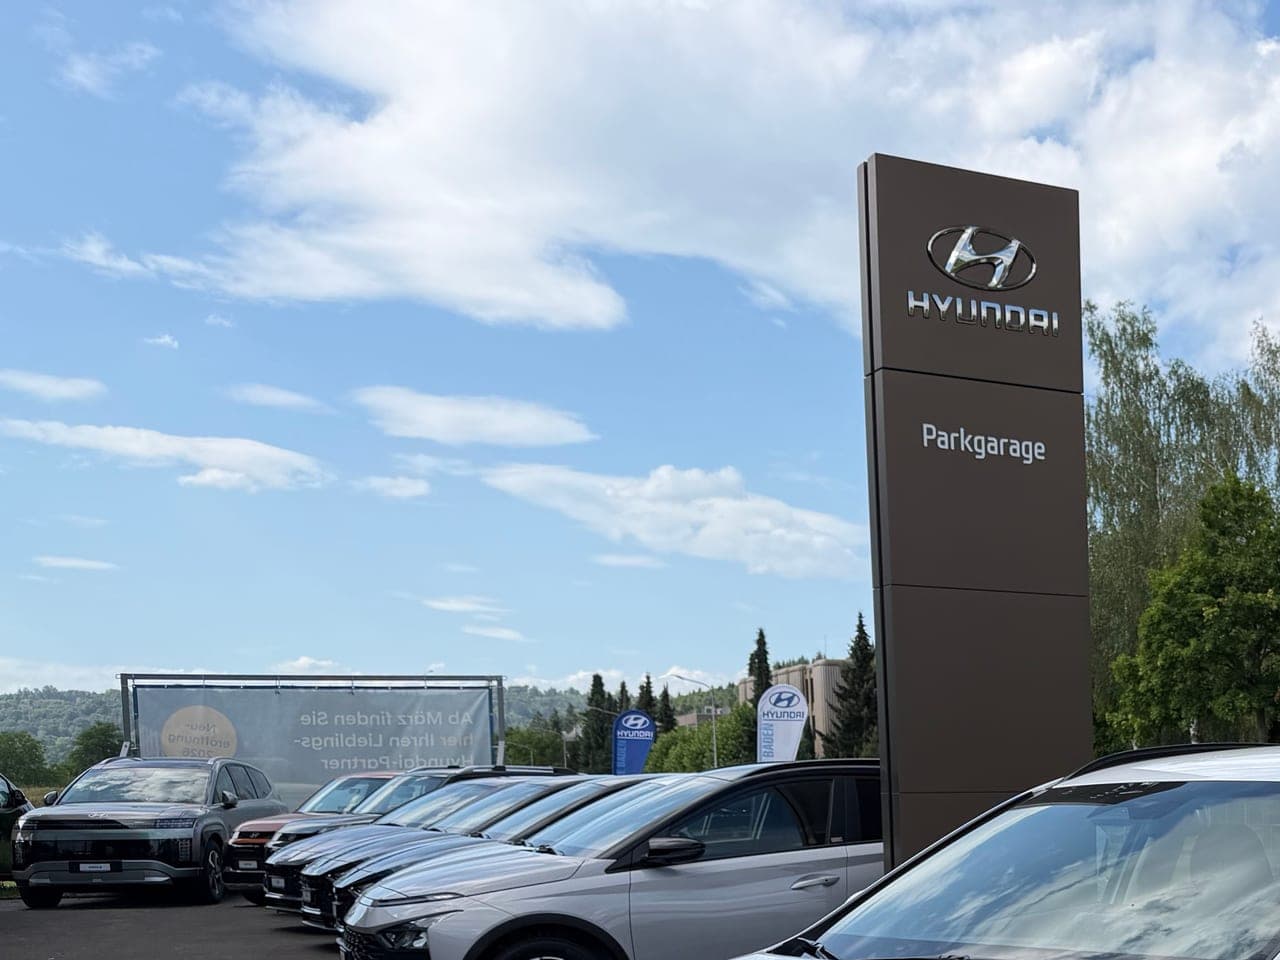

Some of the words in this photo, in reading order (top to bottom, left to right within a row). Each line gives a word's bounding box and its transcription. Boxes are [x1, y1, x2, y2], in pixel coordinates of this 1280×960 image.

[907, 290, 1059, 337] HYUNDAI
[922, 423, 1046, 465] Parkgarage
[762, 711, 805, 719] HYUNDAI
[617, 730, 654, 738] HYUNDAI
